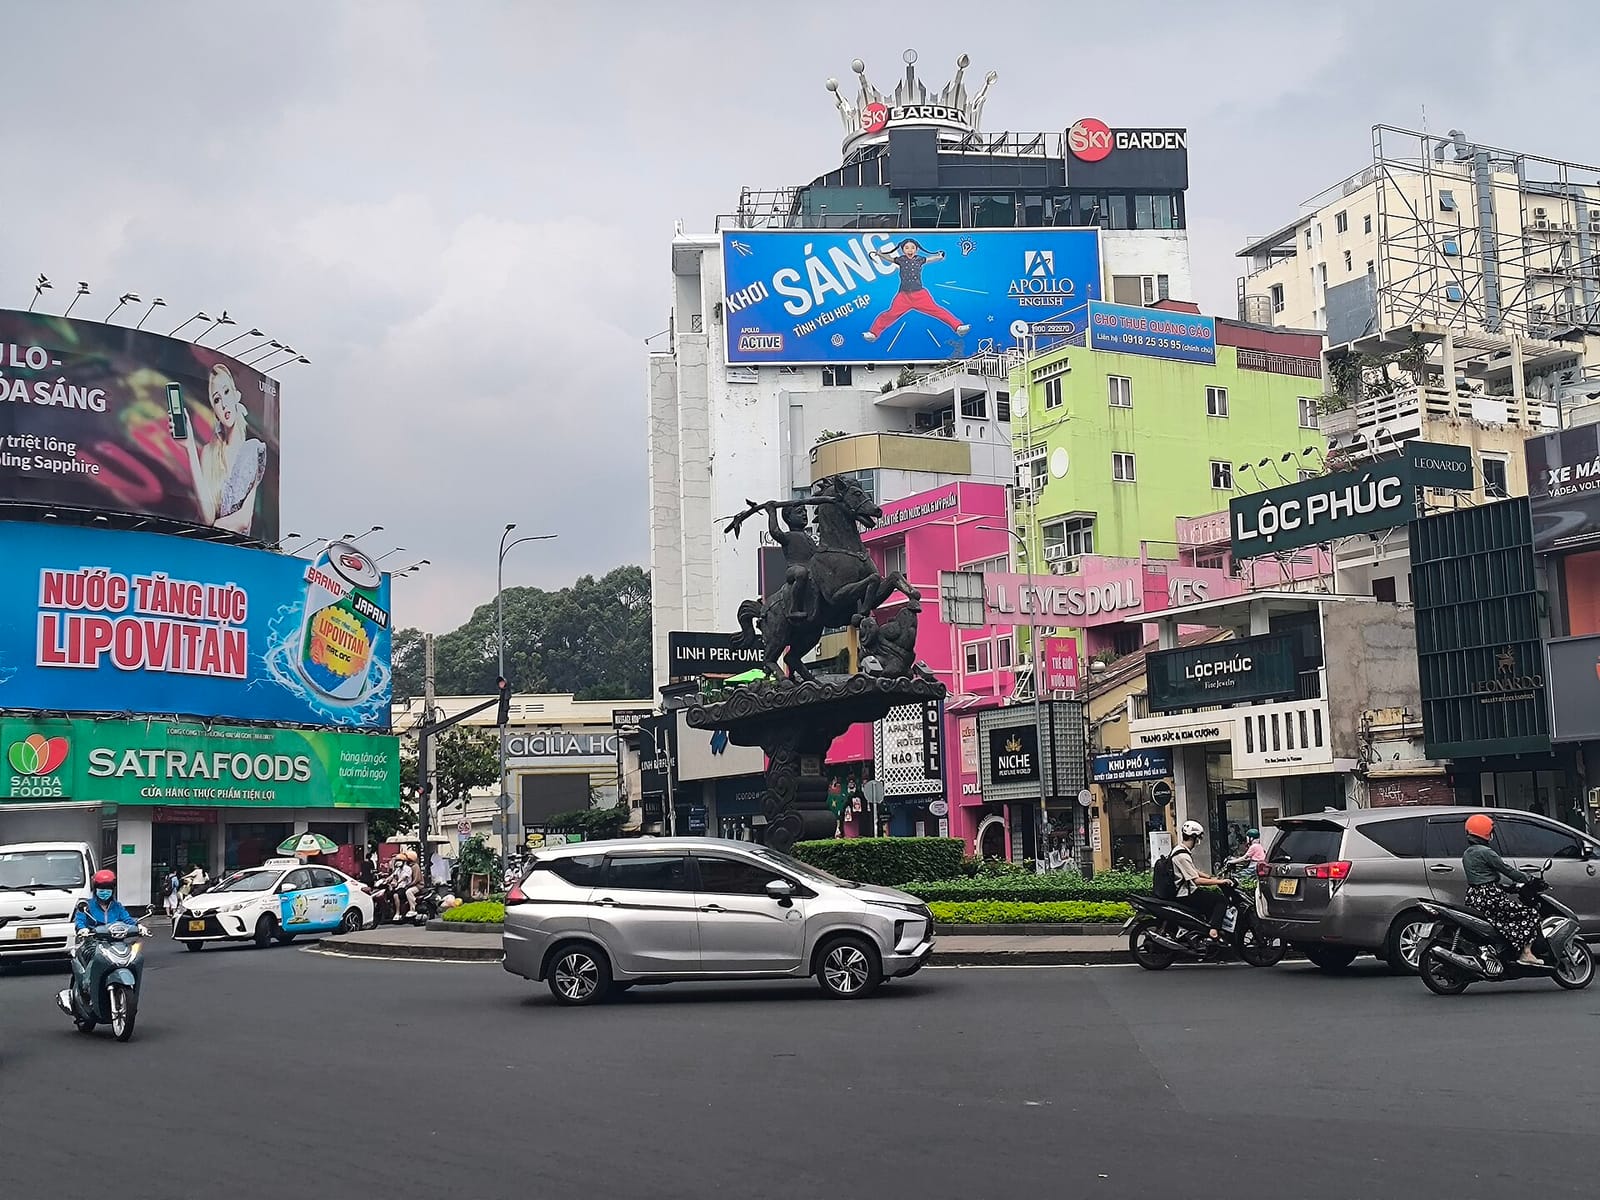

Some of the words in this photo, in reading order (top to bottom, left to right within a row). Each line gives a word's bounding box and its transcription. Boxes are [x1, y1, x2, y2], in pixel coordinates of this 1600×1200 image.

[861, 109, 887, 129] SKY
[891, 106, 970, 125] GARDEN
[1068, 121, 1112, 152] SKY
[1116, 132, 1186, 149] GARDEN
[772, 233, 900, 316] SÁNG
[1008, 278, 1074, 293] APOLLO
[1019, 297, 1064, 306] ENGLISH
[793, 322, 816, 338] TÌNH
[816, 311, 835, 327] YÊU
[835, 302, 854, 319] HỌC
[855, 294, 871, 311] TẬP
[1094, 313, 1117, 326] CHO
[1119, 316, 1147, 330] THUÊ
[1149, 319, 1186, 336] QUẢNG
[1188, 324, 1211, 339] CÁO
[741, 336, 781, 350] ACTIVE
[1097, 333, 1109, 341] Liên
[1122, 333, 1143, 345] 0918
[1145, 337, 1156, 346] 25
[1158, 338, 1169, 349] 35
[1171, 341, 1181, 350] 95
[10, 343, 48, 370] LO
[33, 377, 106, 412] SÁNG
[7, 434, 41, 453] triệt
[44, 436, 76, 456] lông
[0, 452, 31, 471] ling
[34, 455, 99, 474] Sapphire
[1414, 456, 1467, 472] LEONARDO
[1547, 466, 1571, 485] XE
[1548, 485, 1578, 498] YADEA
[1237, 498, 1301, 542] LỘC
[1306, 473, 1402, 525] PHÚC
[42, 568, 128, 611] NƯỚC
[134, 573, 203, 617] TĂNG
[206, 583, 247, 624] LỰC
[307, 566, 341, 597] BRAND
[354, 597, 387, 626] JAPAN
[1085, 578, 1141, 615] DOLL
[40, 613, 246, 676] LIPOVITAN
[319, 617, 364, 655] LIPOVITAN
[676, 647, 705, 659] LINH
[710, 647, 765, 661] PERFUME
[1185, 659, 1213, 681] LỘC
[1214, 653, 1252, 675] PHÚC
[1471, 675, 1541, 693] LEONARDO
[508, 736, 583, 755] CICILIA
[1140, 734, 1161, 744] TRANG
[1181, 731, 1193, 739] KIM
[88, 748, 311, 781] SATRAFOODS
[340, 750, 360, 765] hàng
[374, 751, 387, 765] gốc
[891, 750, 912, 764] HÀO
[998, 753, 1031, 769] NICHE
[1108, 759, 1124, 771] KHU
[1126, 753, 1142, 769] PHỐ
[1144, 757, 1149, 767] 4
[11, 776, 62, 786] SATRA
[370, 767, 388, 781] ngày
[10, 787, 62, 797] FOODS
[140, 784, 162, 797] CỬA
[165, 786, 190, 797] HÀNG
[193, 787, 216, 800] THỰC
[217, 786, 240, 799] PHẨM
[242, 788, 260, 800] TIỆN
[262, 789, 275, 800] LỢI
[963, 782, 981, 795] DOLL
